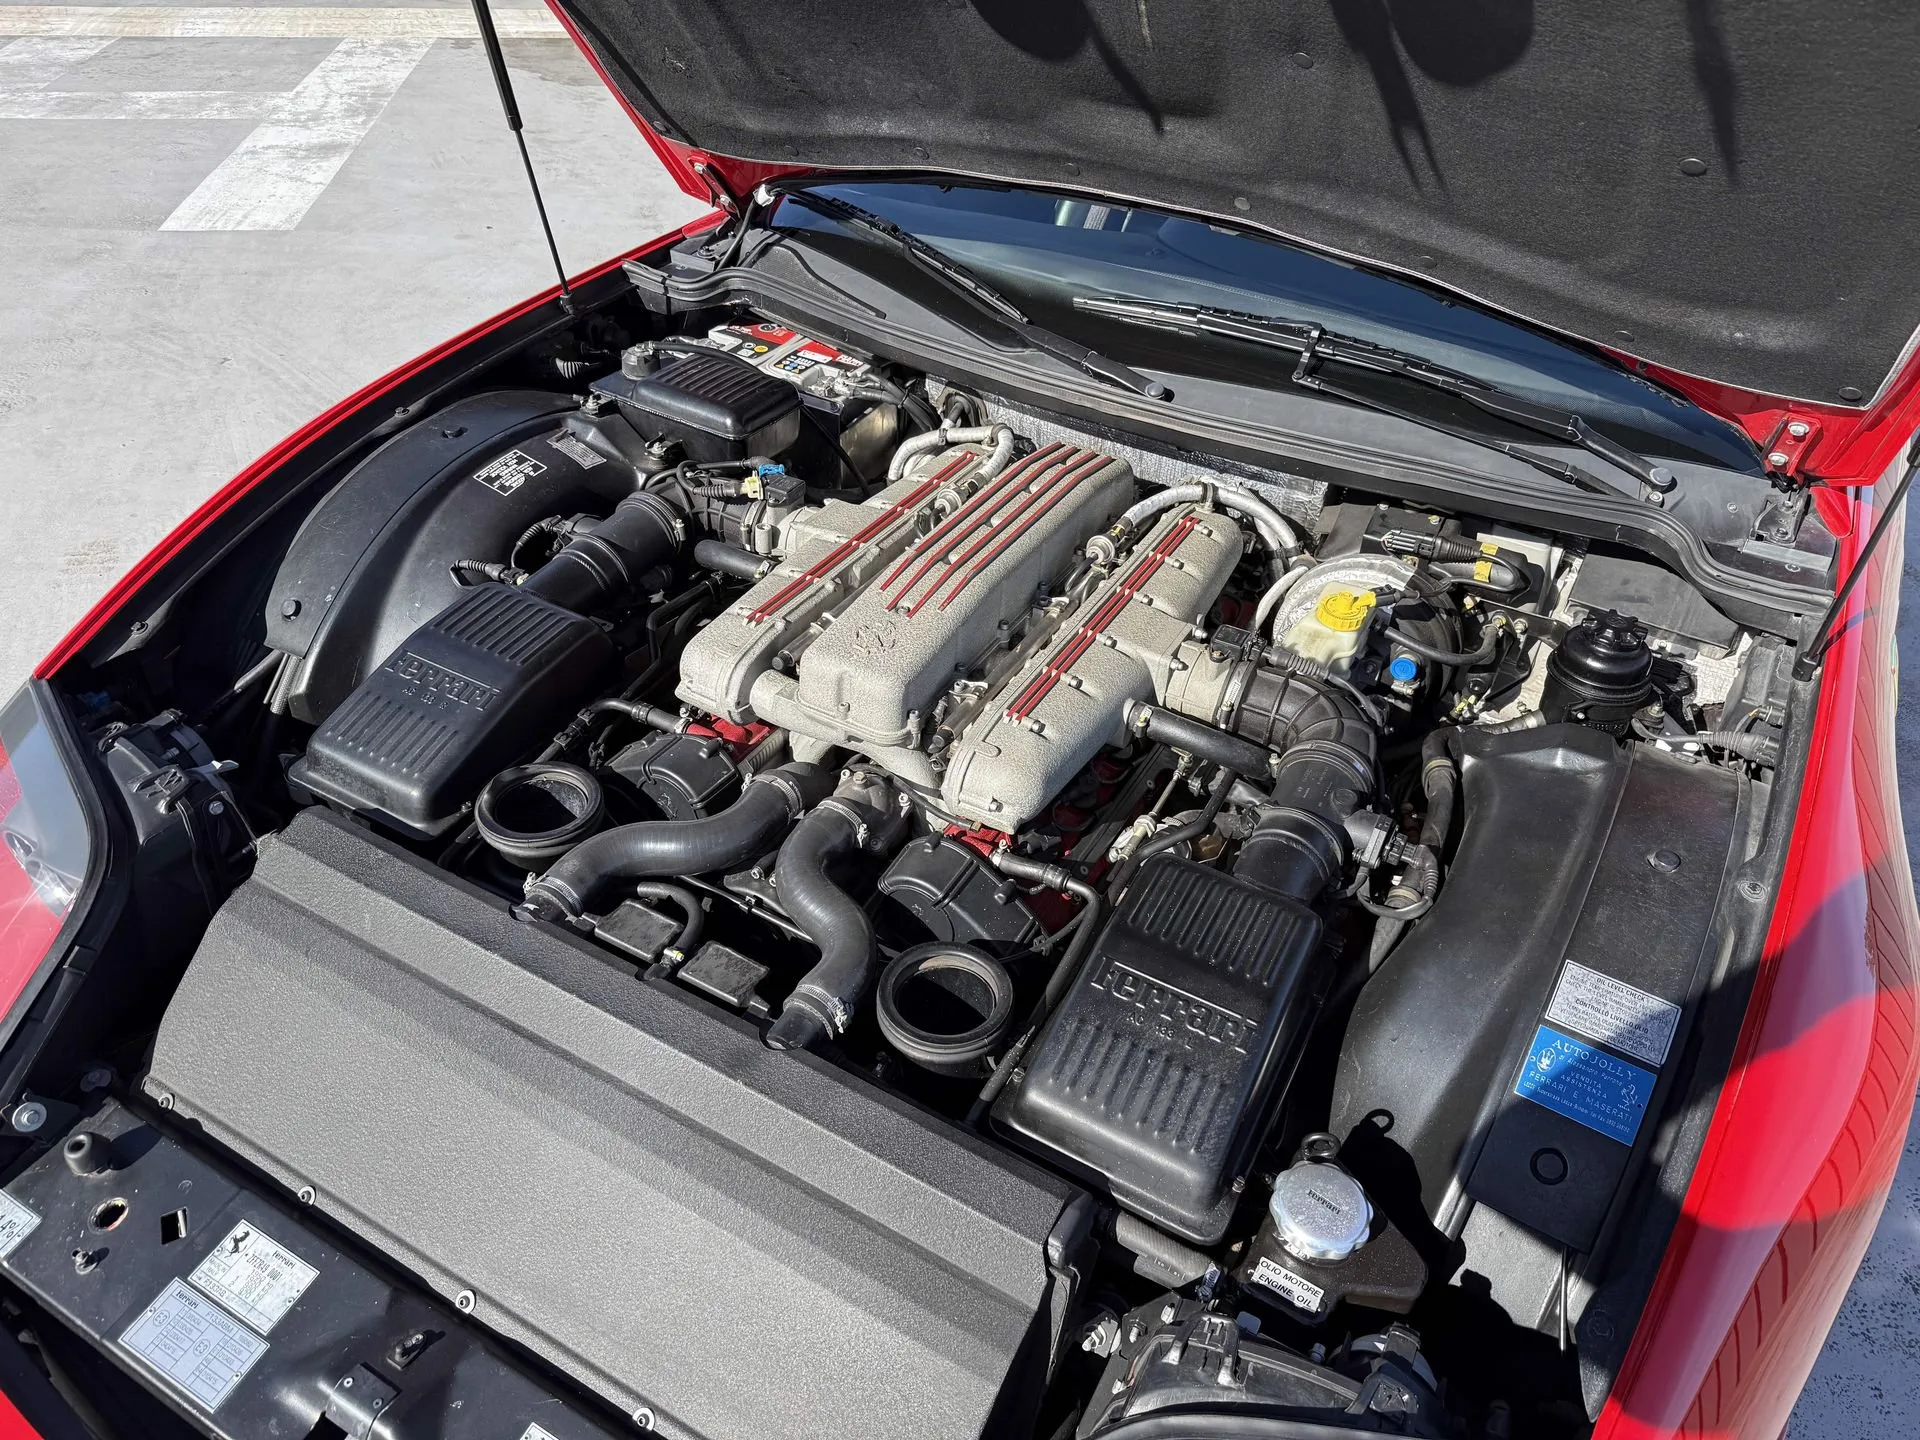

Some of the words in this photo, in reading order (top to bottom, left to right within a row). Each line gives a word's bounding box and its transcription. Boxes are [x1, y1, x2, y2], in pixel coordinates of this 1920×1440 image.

[385, 651, 502, 711] Ferrari
[1090, 957, 1260, 1054] Ferrari
[1596, 977, 1606, 985] OIL
[1606, 981, 1625, 993] LEVEL
[1625, 989, 1646, 1002] CHECK
[1574, 997, 1609, 1017] CONTROLLO
[1609, 1012, 1634, 1027] LIVELLO
[1634, 1023, 1649, 1034] OLIO
[1551, 1037, 1636, 1081] AUTOJOLLY
[1528, 1070, 1567, 1093] FERRARI
[1572, 1090, 1579, 1098] E
[1585, 1096, 1632, 1122] MASERATI
[1560, 1073, 1608, 1099] ASSISTENZA
[1569, 1070, 1602, 1089] VENDITA
[1307, 1189, 1341, 1215] Ferrari
[271, 1249, 297, 1269] Ferrari
[1258, 1273, 1294, 1297] ENGINE
[1297, 1294, 1312, 1308] OIL
[1260, 1261, 1282, 1276] OLIO
[1283, 1273, 1322, 1298] MOTORE
[175, 1288, 200, 1309] Ferrari
